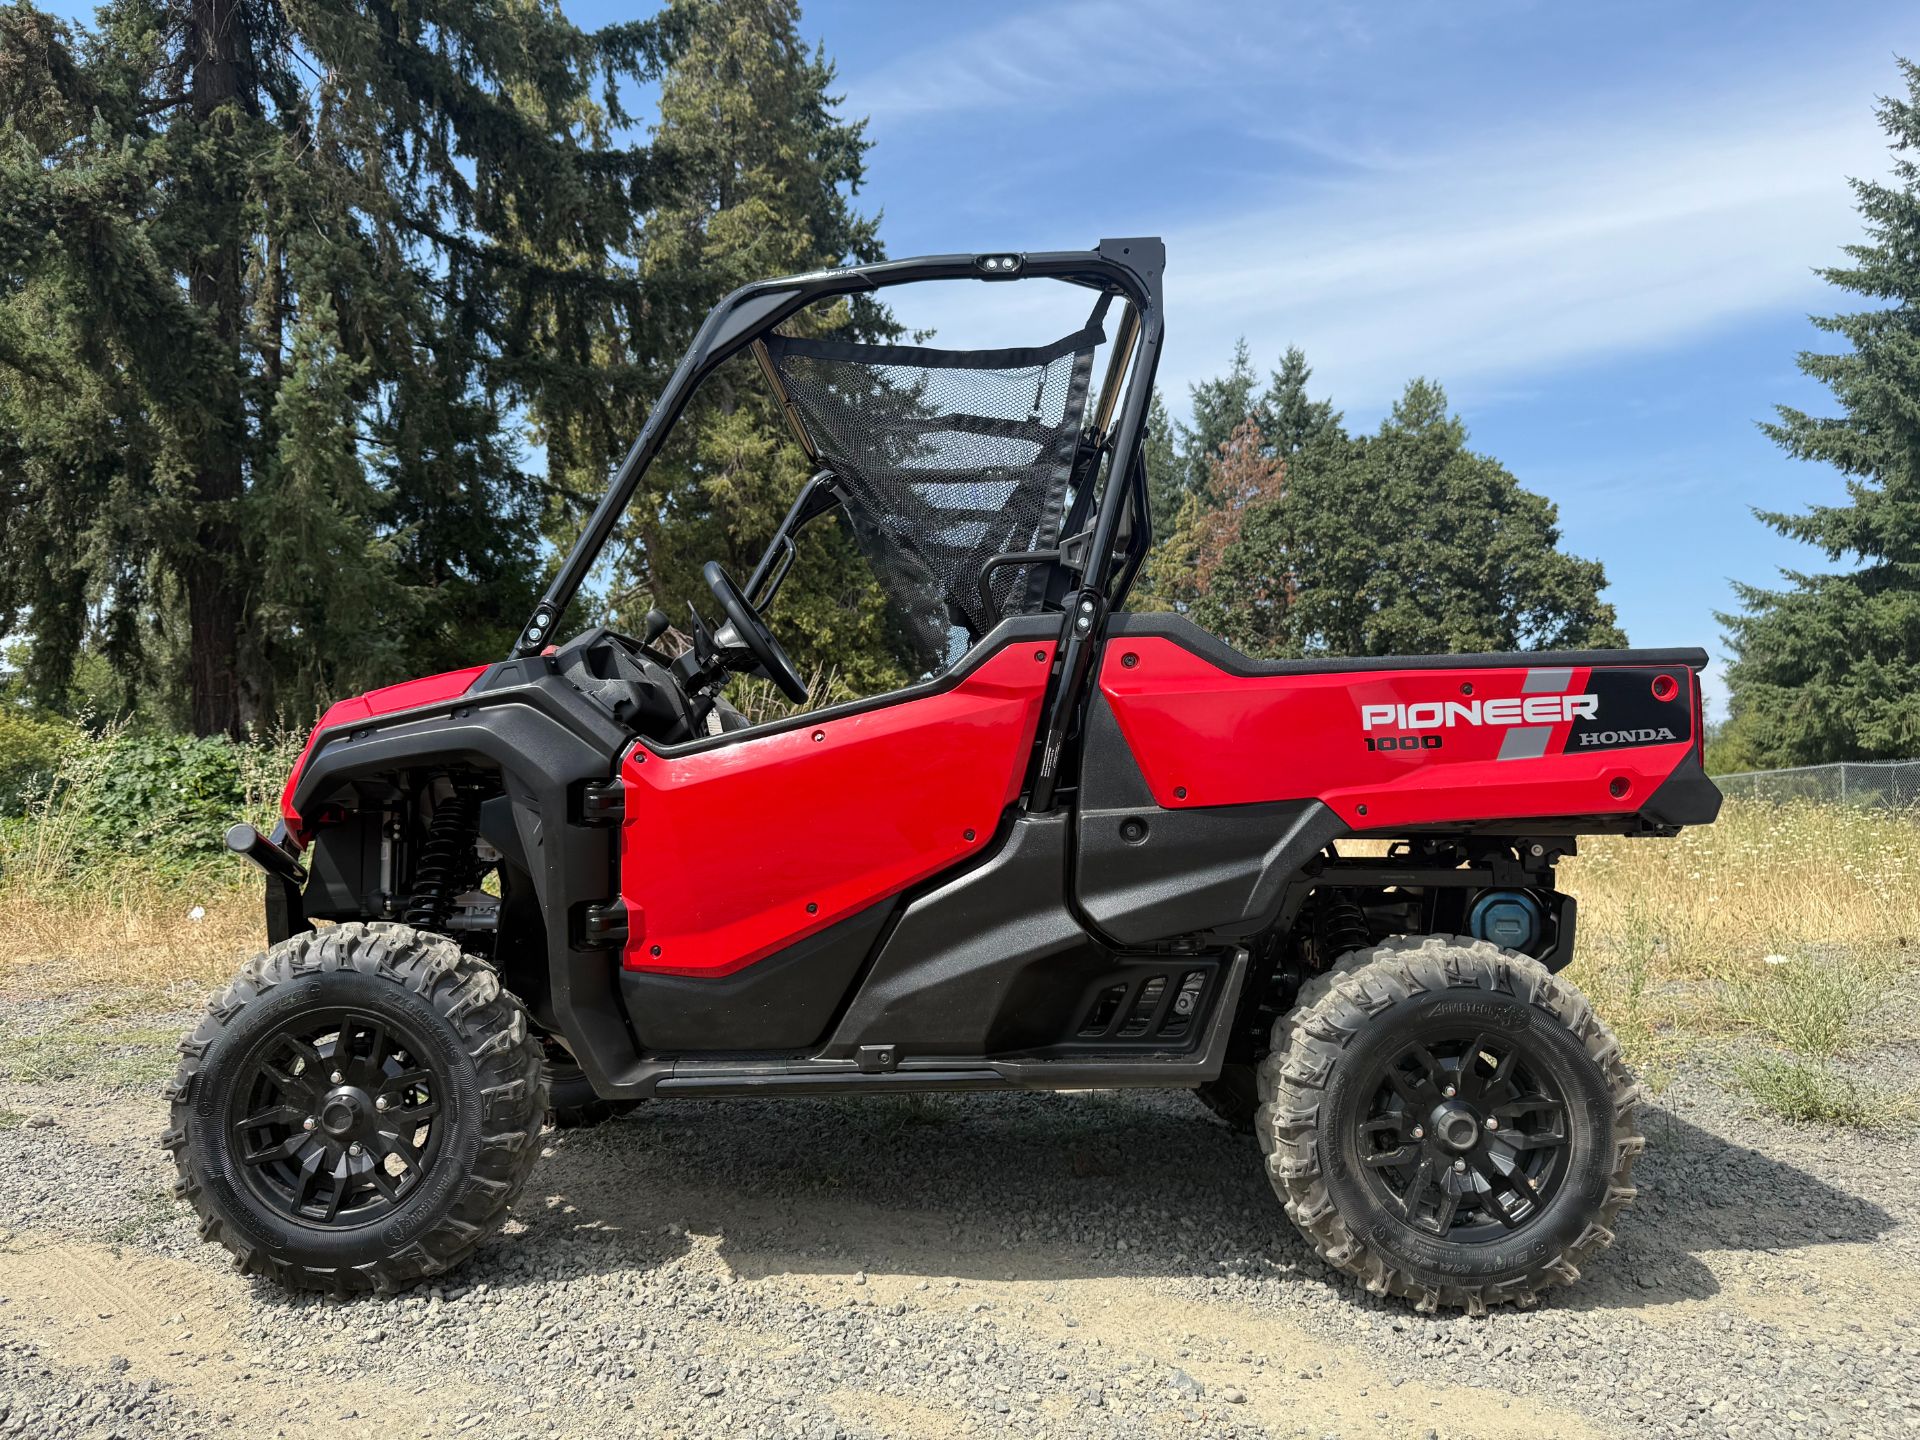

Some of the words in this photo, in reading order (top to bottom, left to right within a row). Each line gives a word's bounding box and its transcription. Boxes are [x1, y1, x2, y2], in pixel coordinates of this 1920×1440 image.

[1362, 693, 1599, 731] PIONEER
[1363, 735, 1443, 752] 1000
[1579, 727, 1676, 747] HONDA
